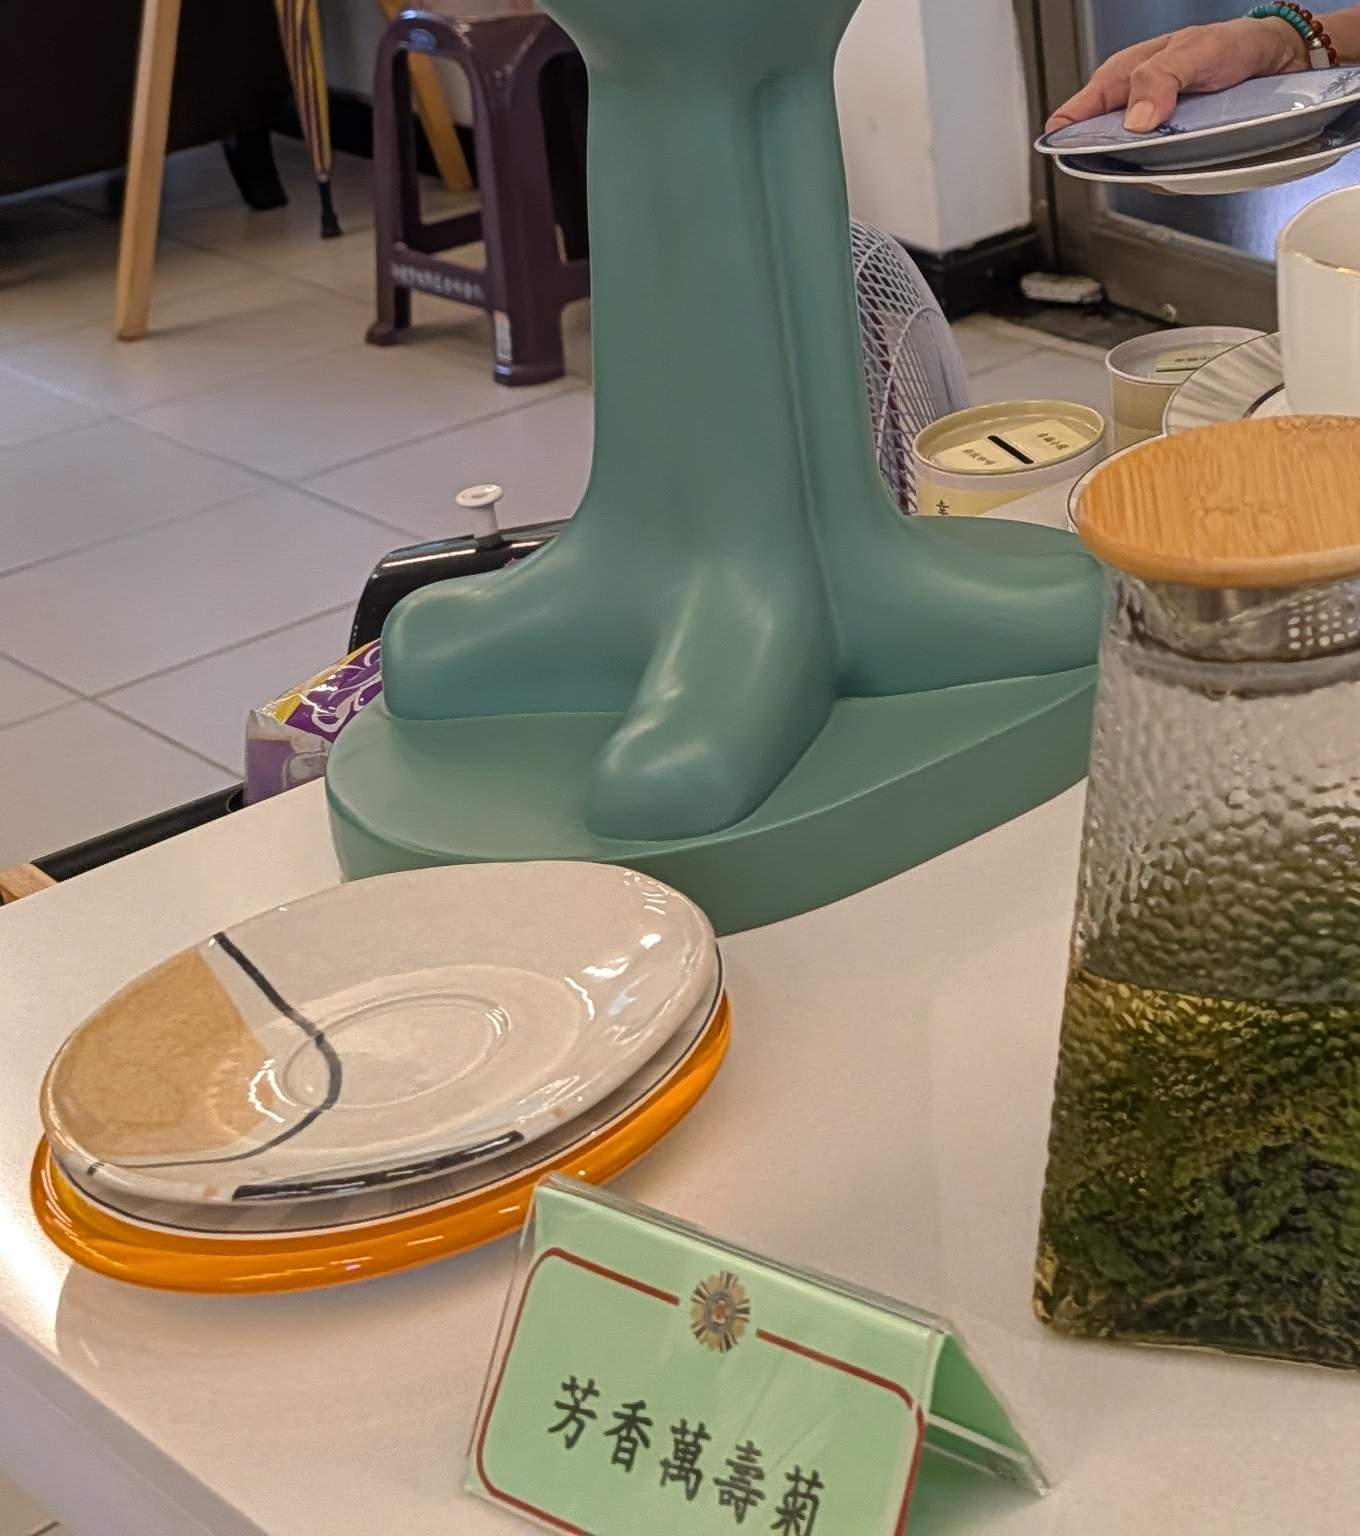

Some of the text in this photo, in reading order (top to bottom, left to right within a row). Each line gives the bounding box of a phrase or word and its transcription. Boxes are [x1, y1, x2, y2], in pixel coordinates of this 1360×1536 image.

[547, 1374, 826, 1536] 芳香萬壽菊
